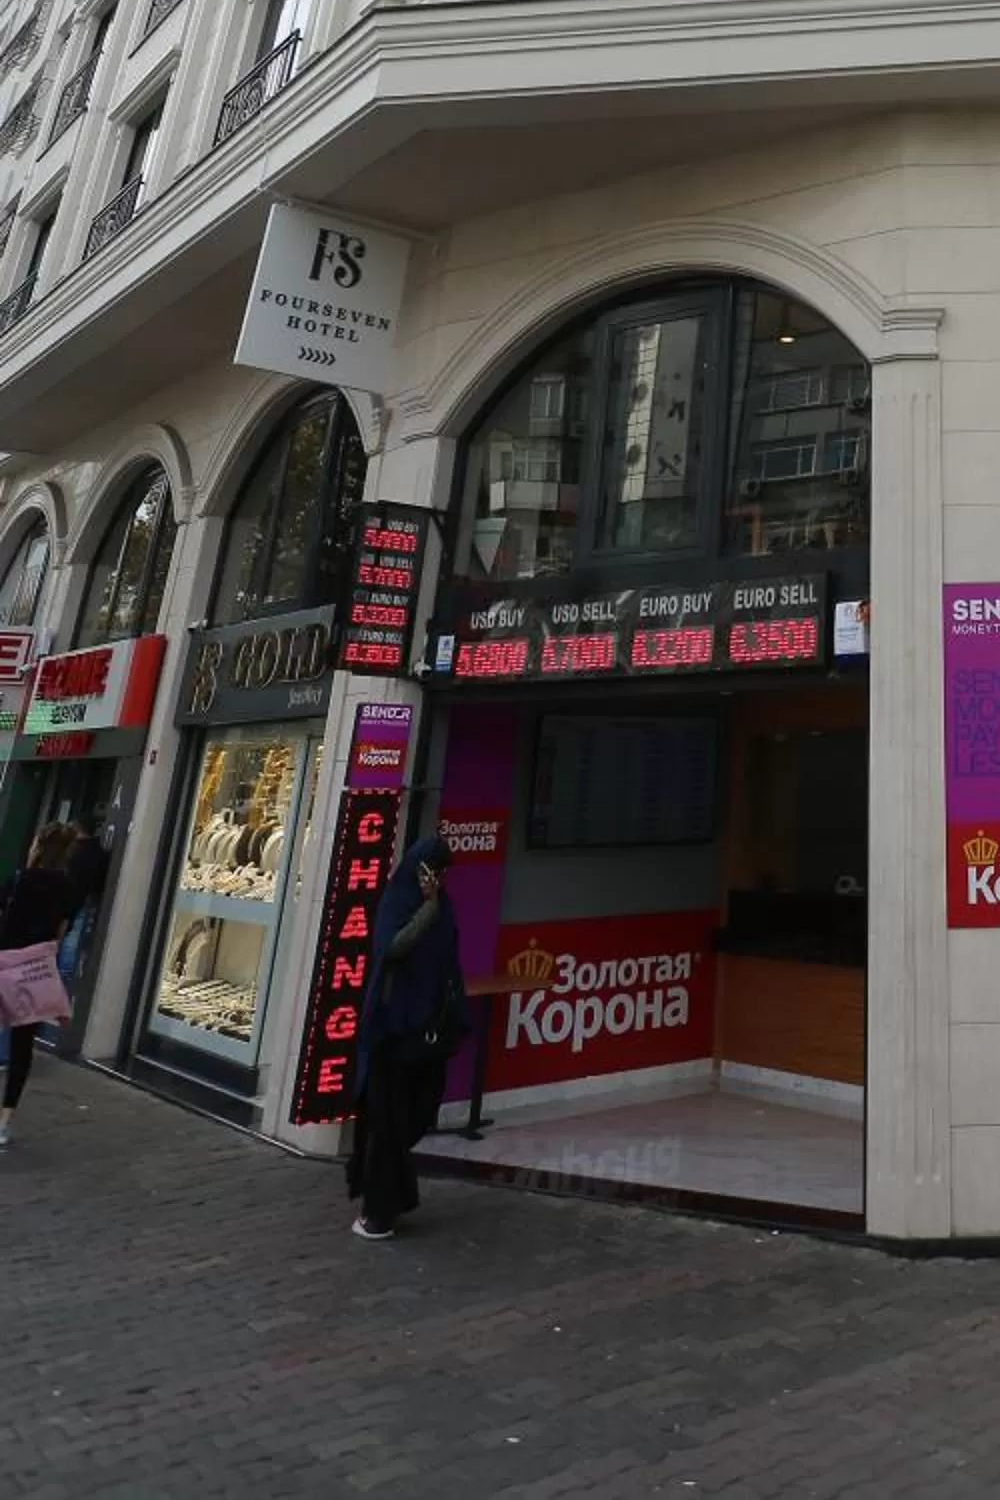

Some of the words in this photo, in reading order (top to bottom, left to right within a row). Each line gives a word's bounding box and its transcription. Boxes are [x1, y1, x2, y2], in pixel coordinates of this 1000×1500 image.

[260, 289, 392, 331] FOURSEVEN
[286, 314, 360, 343] HOTEL
[639, 596, 678, 617] EURO
[681, 592, 713, 613] BUY
[733, 587, 776, 609] EURO
[779, 583, 818, 605] SELL
[471, 611, 496, 629] USD
[499, 608, 525, 628] BUY
[552, 604, 579, 624] USD
[581, 601, 617, 622] SELL
[952, 624, 991, 636] MONEY
[449, 835, 496, 852] рона
[316, 812, 384, 1094] CHANGE
[552, 952, 693, 994] Золотая
[505, 986, 690, 1053] Корона
